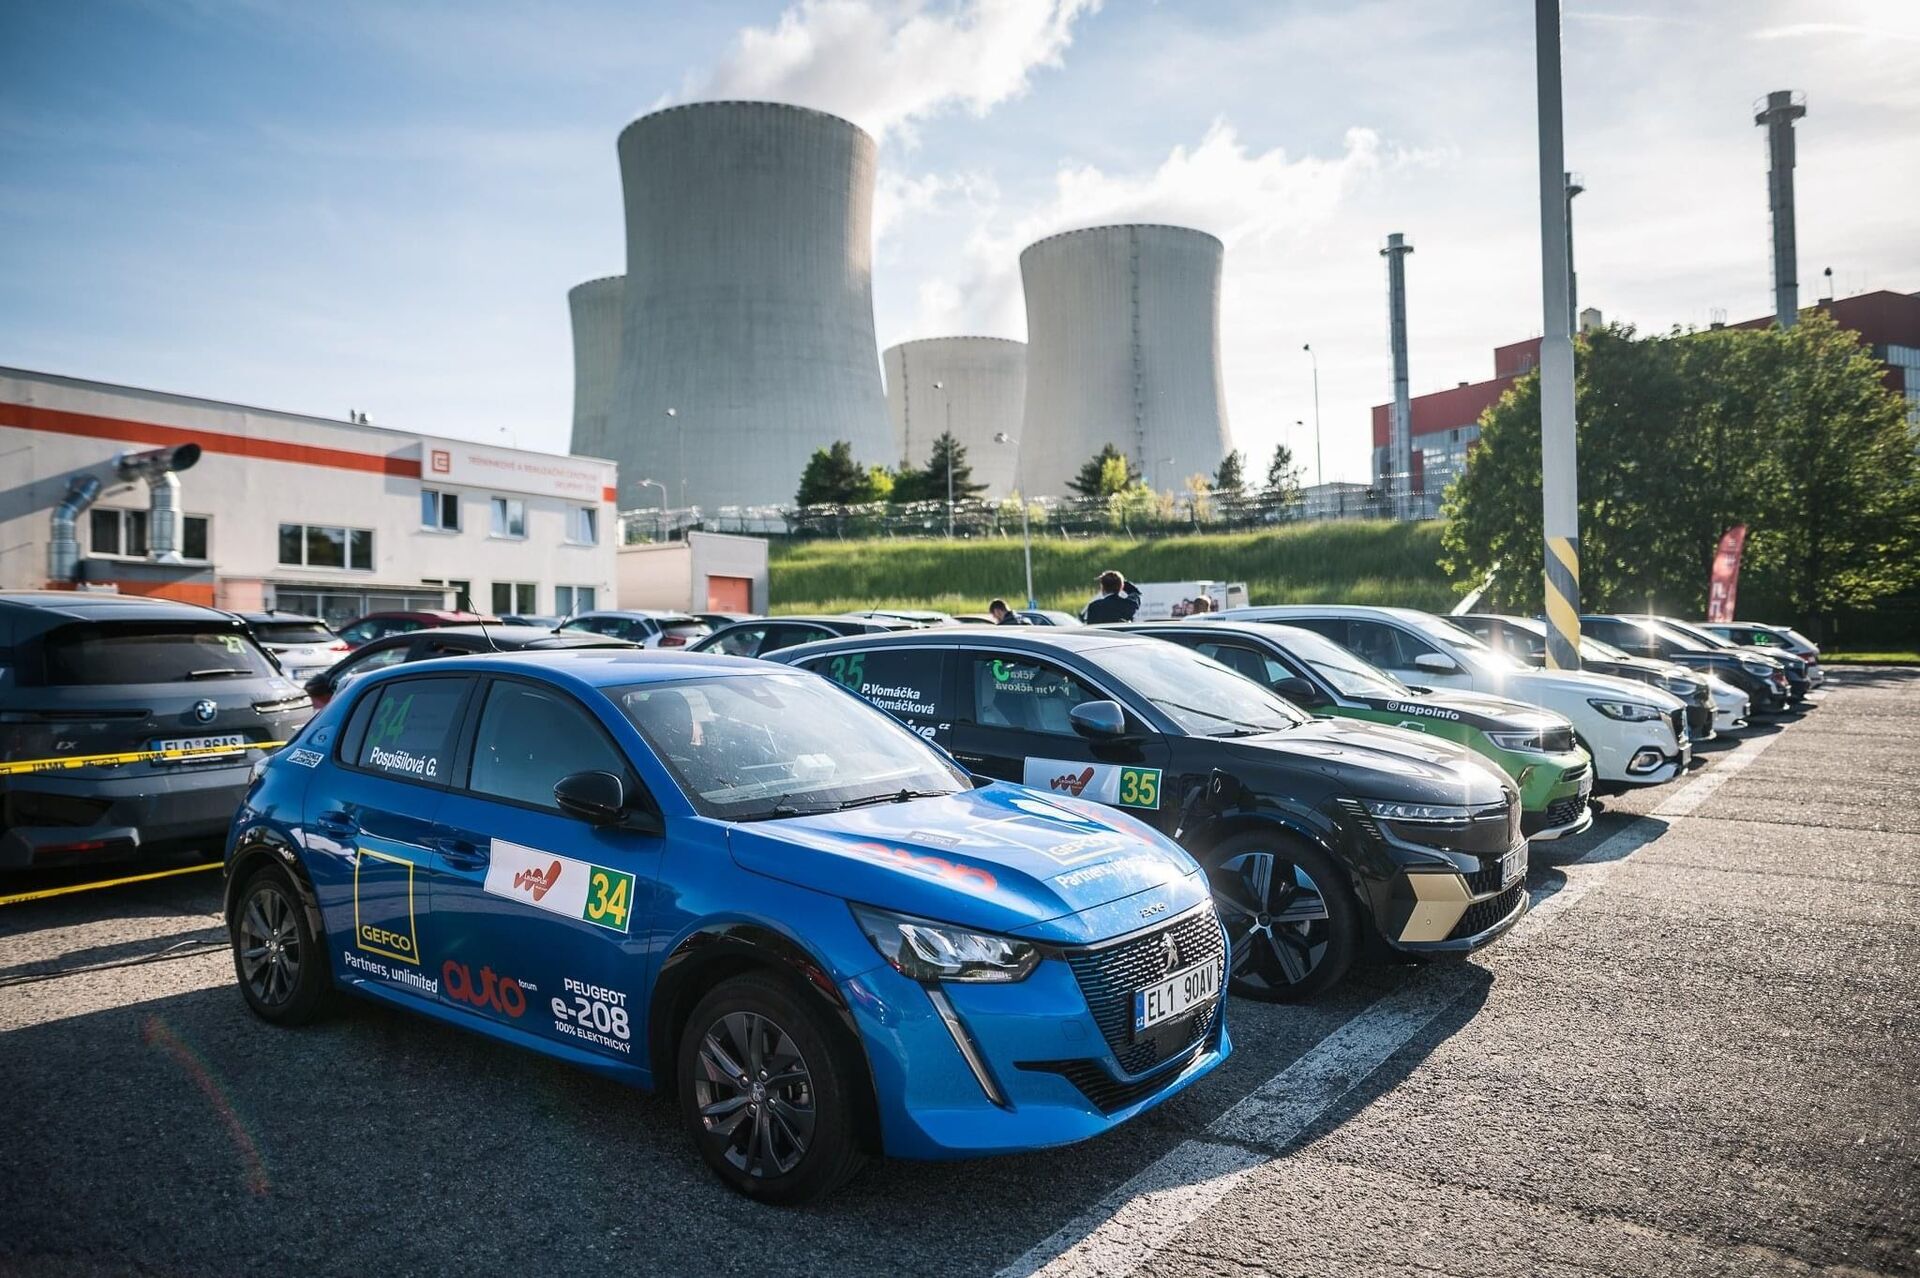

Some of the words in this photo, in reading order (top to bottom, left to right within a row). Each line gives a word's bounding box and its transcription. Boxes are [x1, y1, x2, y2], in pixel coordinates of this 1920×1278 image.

[368, 694, 415, 746] 34
[1400, 703, 1459, 721] uspoinfo
[369, 746, 426, 774] Pospíšilová
[426, 757, 437, 777] G.
[1122, 772, 1155, 805] 35
[588, 873, 627, 925] 34
[361, 925, 411, 951] GEFCO
[344, 951, 390, 980] Partners,
[391, 967, 438, 994] unlimited
[443, 959, 526, 1018] auto
[518, 978, 538, 991] forum
[564, 977, 627, 1007] PEUGEOT
[551, 997, 631, 1040] e-208
[554, 1020, 577, 1036] 100%
[577, 1028, 631, 1054] ELEKTRICKÝ
